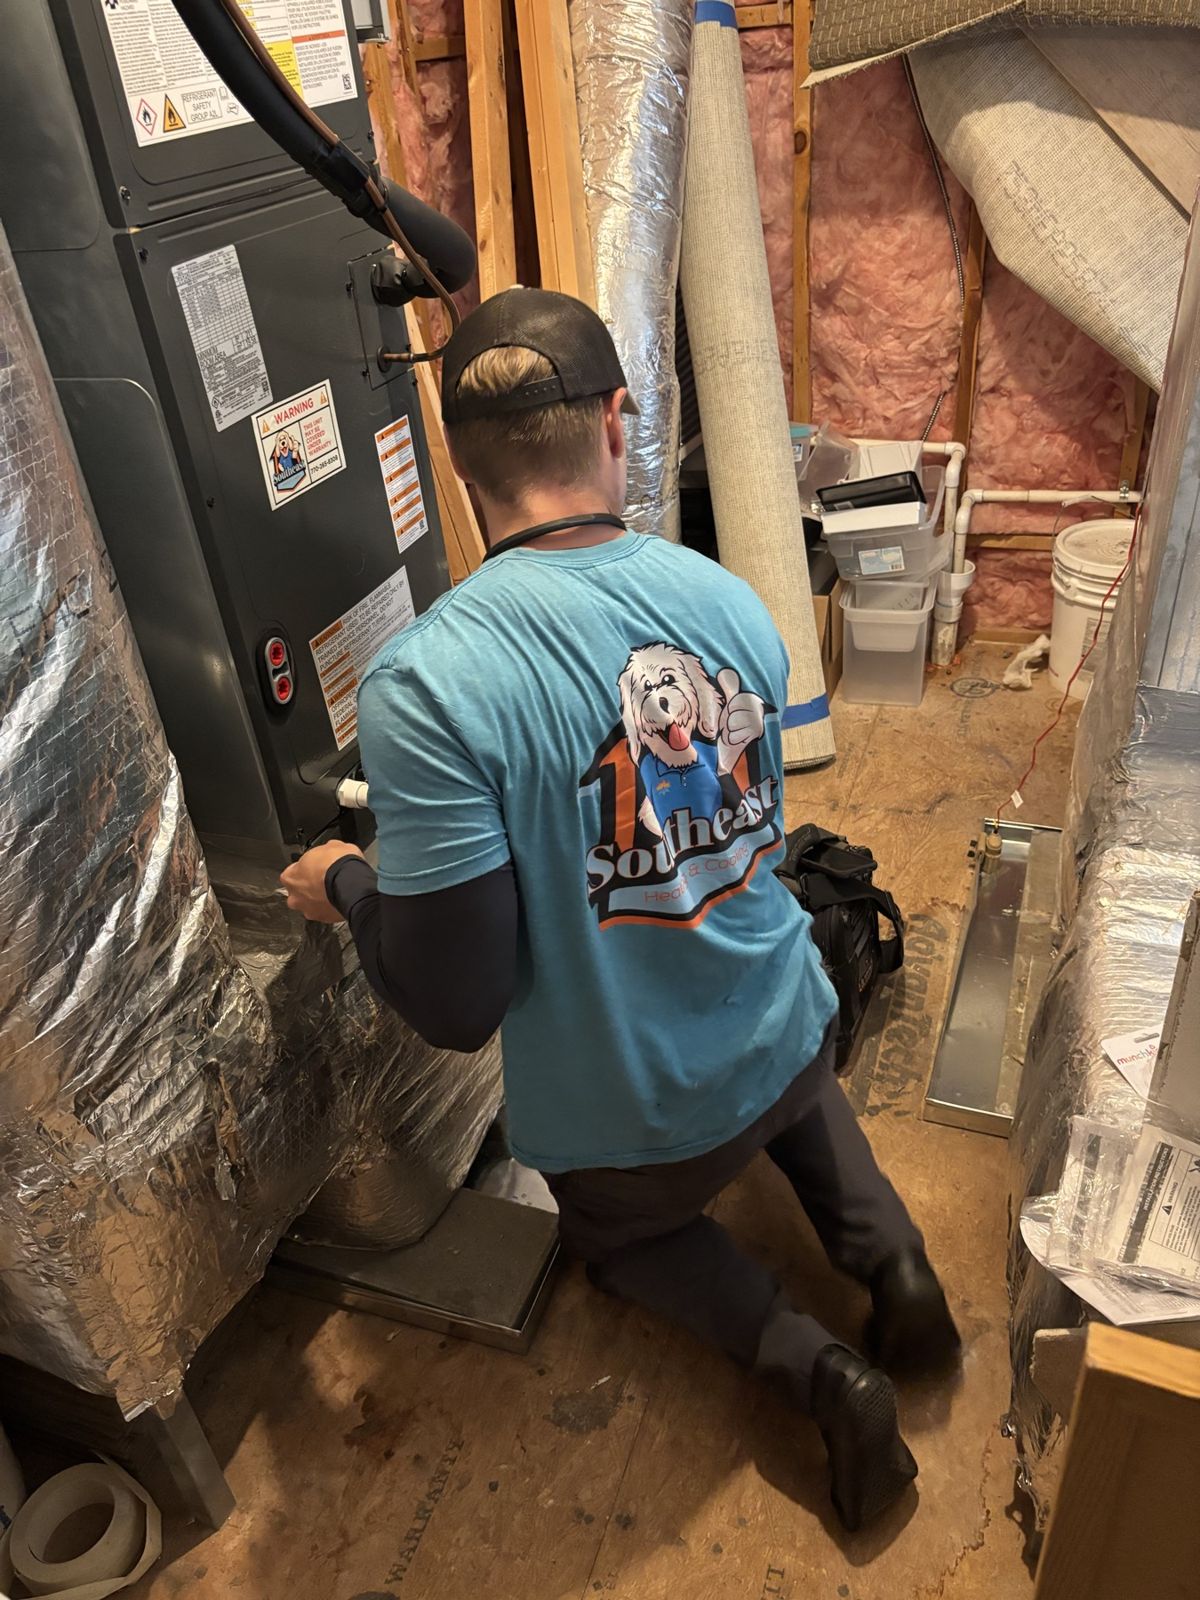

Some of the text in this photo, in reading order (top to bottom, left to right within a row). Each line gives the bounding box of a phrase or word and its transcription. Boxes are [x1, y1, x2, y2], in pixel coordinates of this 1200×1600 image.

[182, 88, 216, 104] REFRIGERANT
[193, 100, 211, 112] SAFETY
[191, 111, 208, 122] GROUP
[273, 397, 315, 425] WARNING
[304, 417, 322, 431] THIS UNIT
[305, 429, 313, 438] MAY
[306, 430, 325, 444] COVERED
[307, 438, 321, 450] UNDER
[308, 440, 331, 456] WARRANTY
[351, 608, 359, 617] OF
[369, 582, 392, 603] FLAMMABLE
[316, 628, 346, 656] REFRIGERANT
[372, 591, 391, 611] REPAIRED
[319, 644, 337, 663] TRAINED
[337, 628, 357, 648] SERVICE
[380, 603, 387, 613] DO
[320, 648, 344, 671] PUNCTURE
[345, 625, 372, 651] REFRIGERANT
[586, 775, 778, 894] Southeast
[688, 862, 700, 878] &
[704, 843, 751, 875] Cooling
[1143, 1147, 1170, 1210] INSTALLATION INSTRUCTIONS
[1167, 1182, 1178, 1203] WARNING
[384, 1439, 465, 1584] WARRANTY
